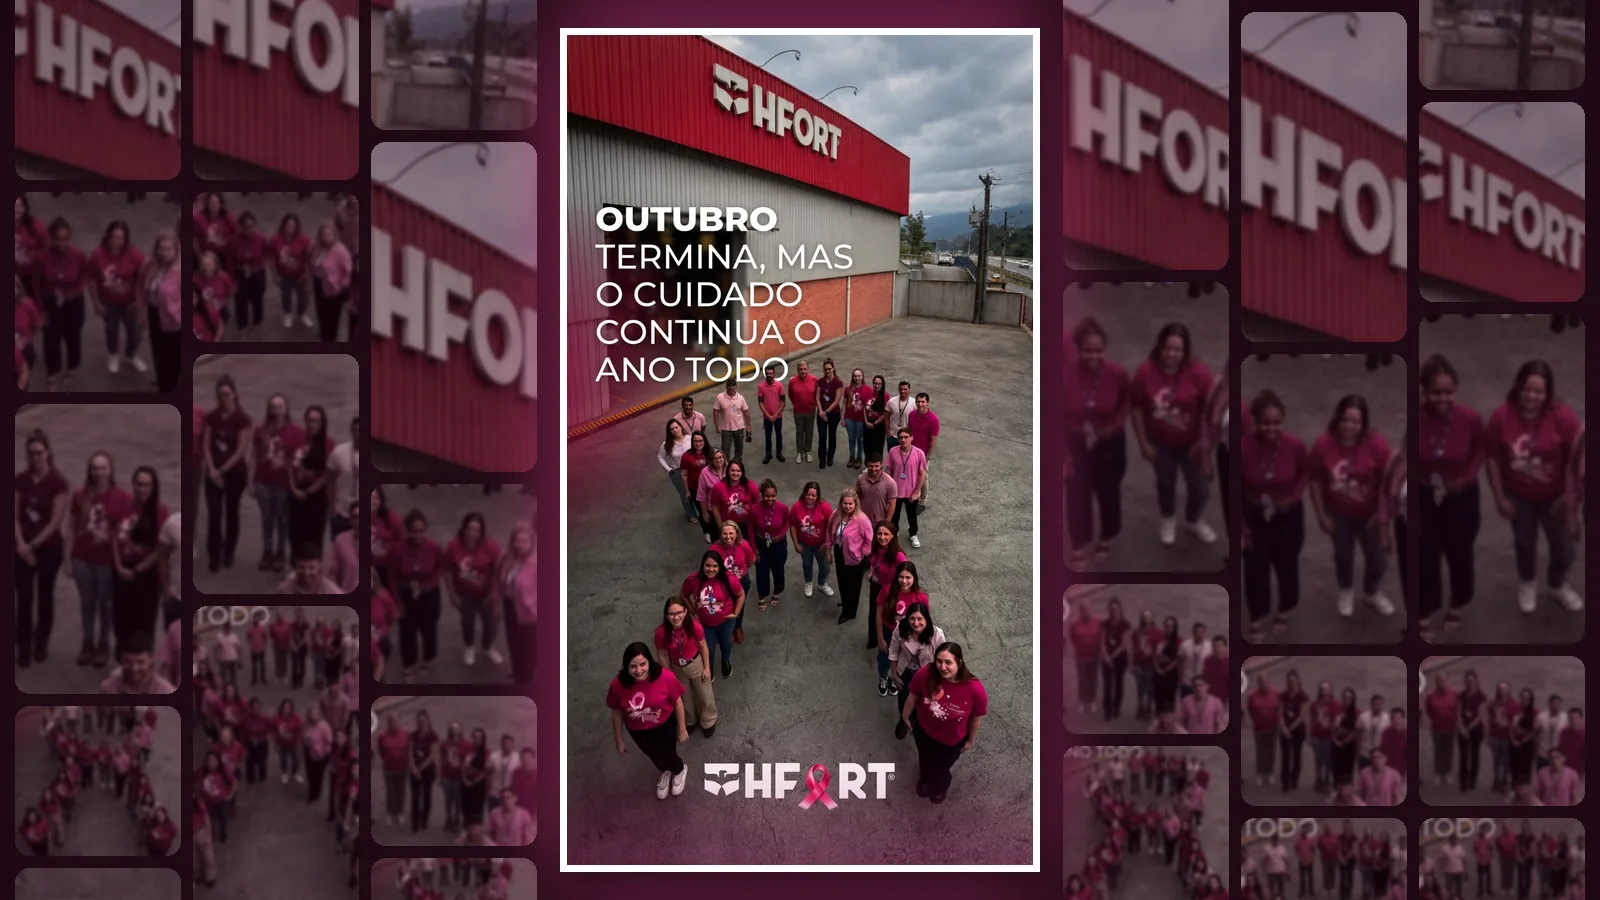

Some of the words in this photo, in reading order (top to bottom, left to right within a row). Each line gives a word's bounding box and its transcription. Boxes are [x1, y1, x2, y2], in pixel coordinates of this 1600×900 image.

[36, 1, 181, 138] HFOR
[752, 83, 842, 160] HFORT
[1450, 152, 1585, 270] HFORT
